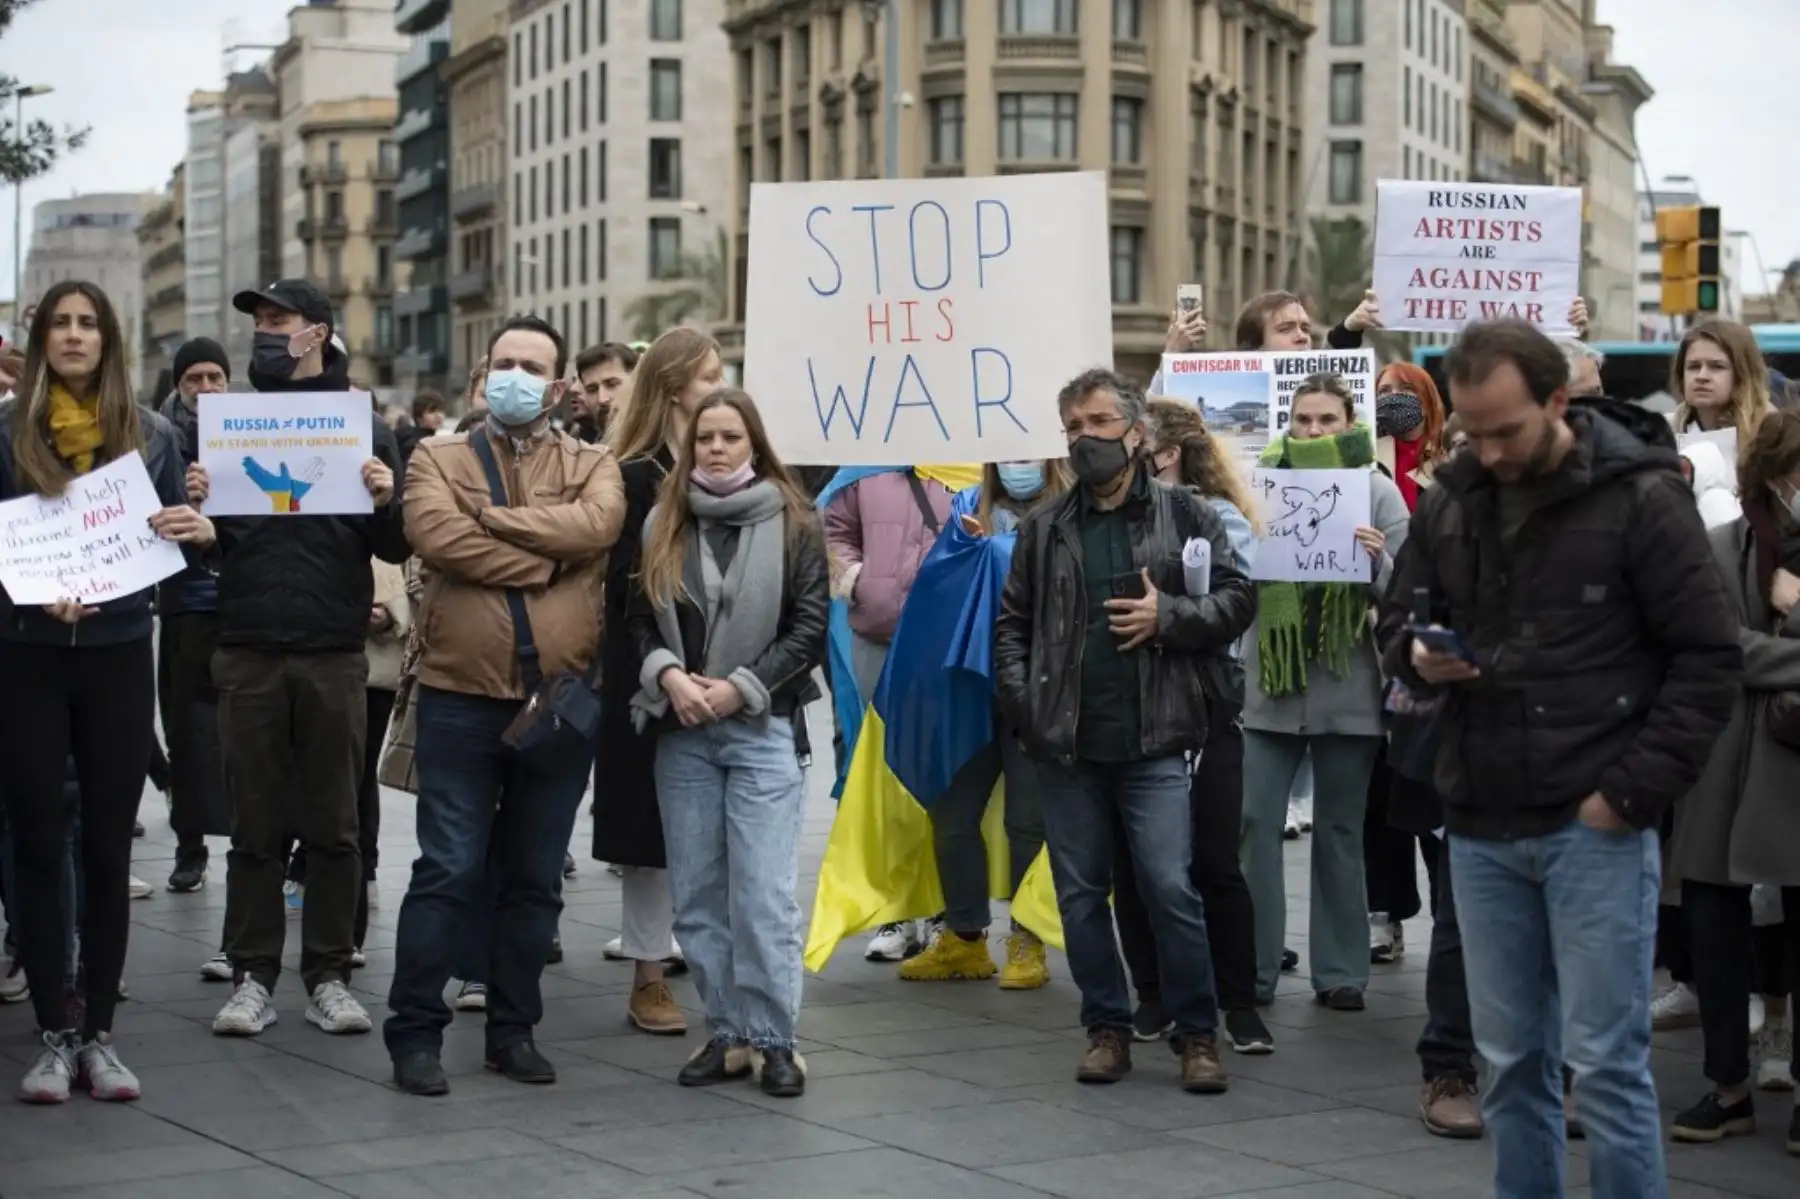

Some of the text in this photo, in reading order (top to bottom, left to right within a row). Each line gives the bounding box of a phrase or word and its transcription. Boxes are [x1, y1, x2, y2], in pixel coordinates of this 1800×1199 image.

[1428, 190, 1528, 210] RUSSIAN
[1413, 217, 1543, 243] ARTISTS
[806, 199, 1012, 297] STOP
[1459, 245, 1497, 259] ARE
[1408, 267, 1543, 292] AGAINST
[867, 298, 955, 344] HIS
[1404, 298, 1545, 323] THE WAR
[1172, 359, 1264, 373] CONFISCAR YA!
[1273, 354, 1371, 376] VERGÜENZA
[807, 347, 1029, 443] WAR
[223, 417, 279, 431] RUSSIA
[296, 416, 345, 430] PUTIN
[207, 437, 225, 449] WE
[227, 437, 269, 449] STAND
[271, 437, 302, 449] WITH
[84, 477, 128, 504] help
[83, 498, 126, 532] NOW
[80, 532, 121, 558] your
[101, 541, 132, 565] will
